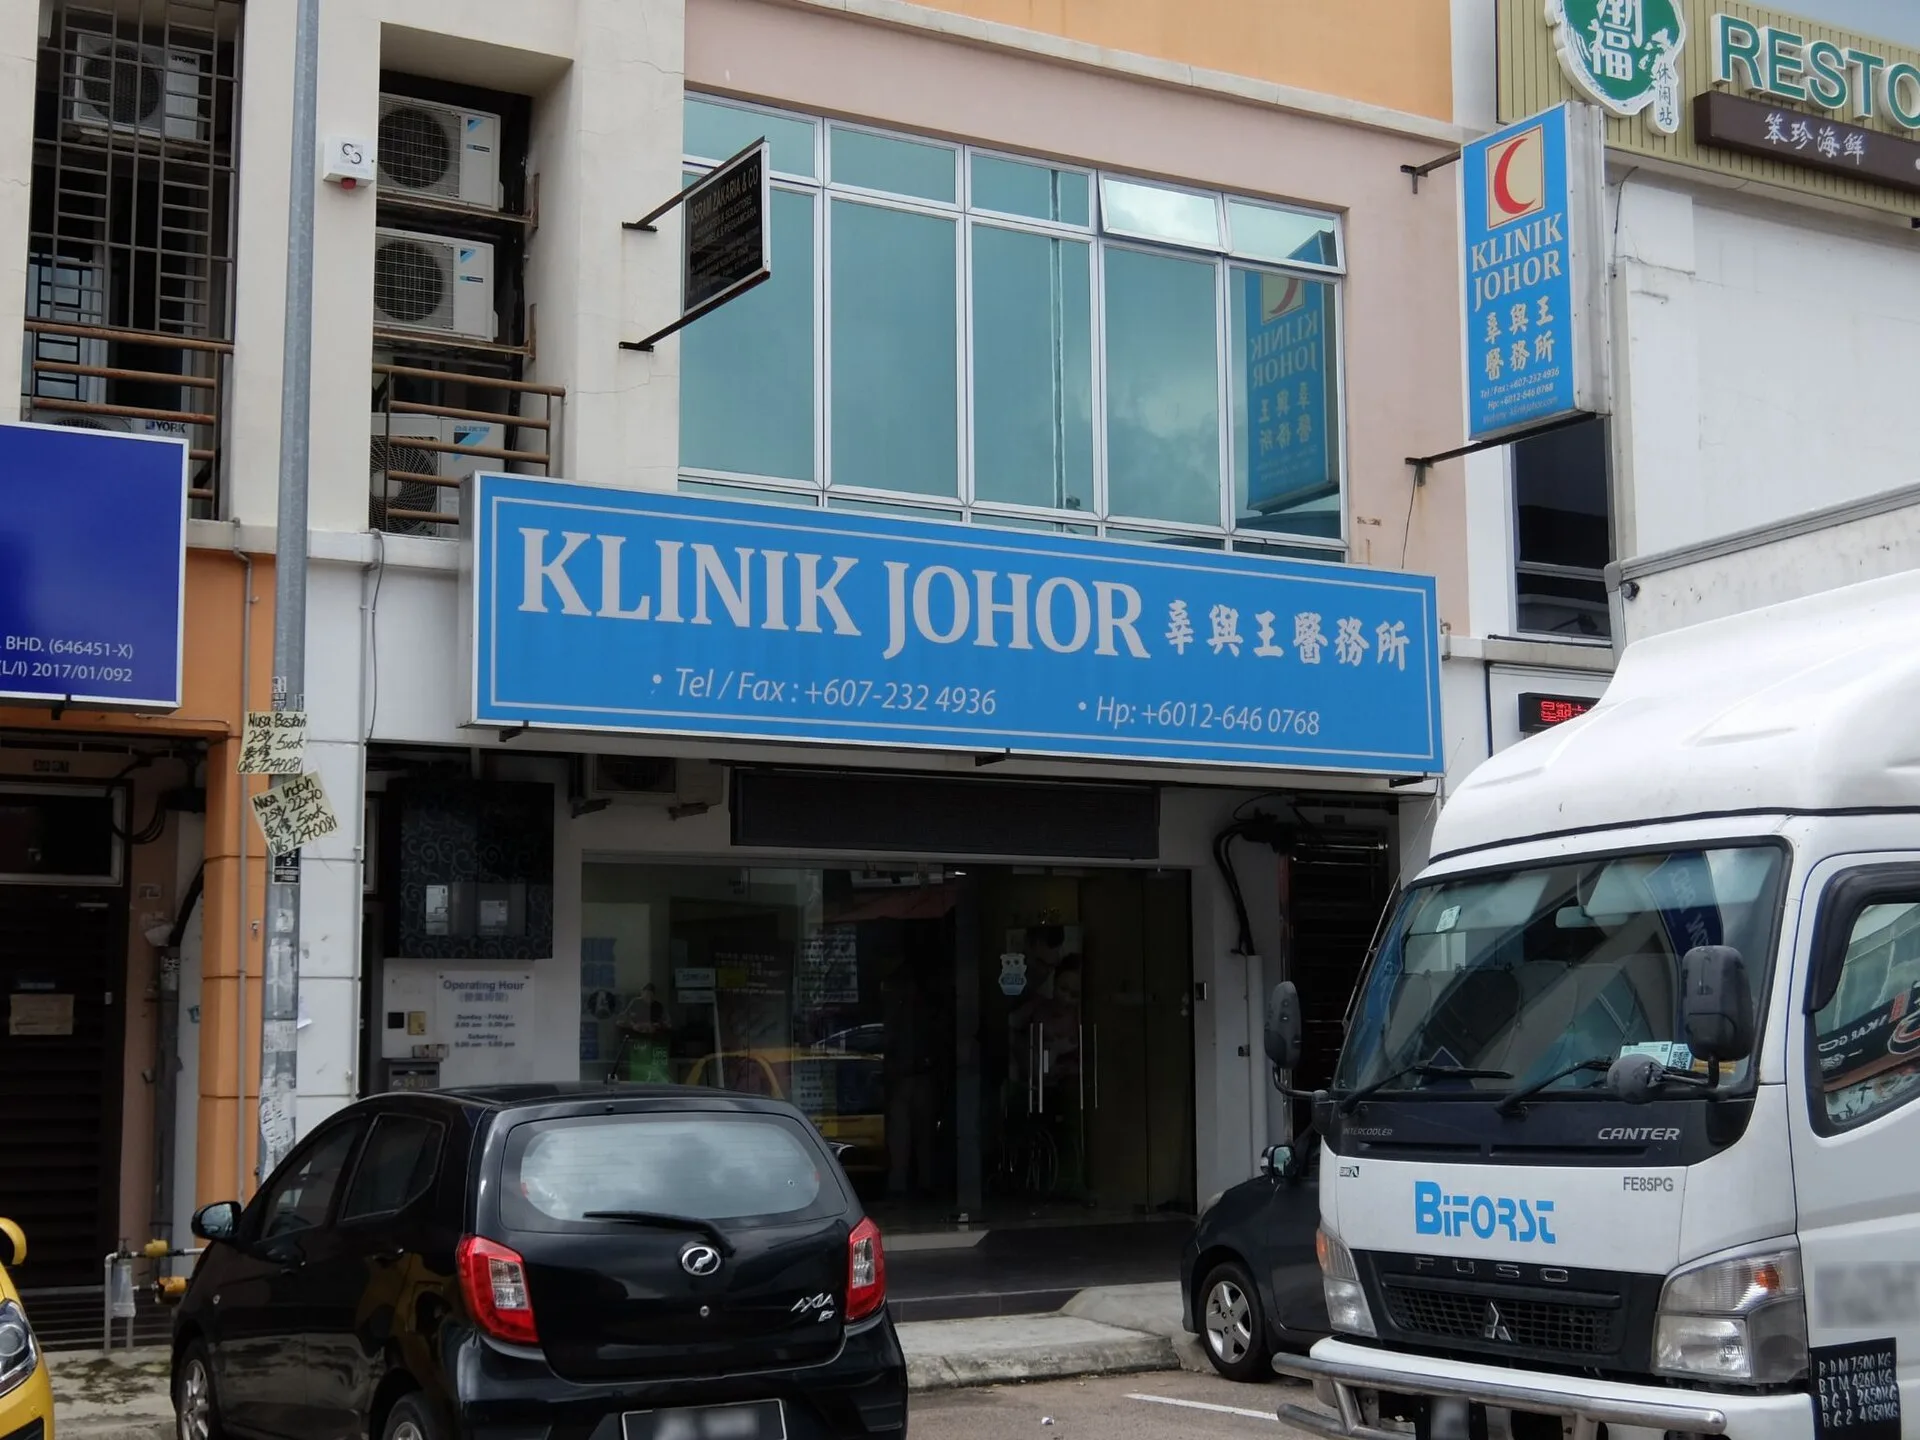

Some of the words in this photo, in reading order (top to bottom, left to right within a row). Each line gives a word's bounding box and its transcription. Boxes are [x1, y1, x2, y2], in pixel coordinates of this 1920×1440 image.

[1763, 111, 1866, 165] 笨珍海鲜
[1471, 212, 1563, 273] KLINIK
[1474, 250, 1562, 312] JOHOR
[1485, 330, 1556, 381] 醫務所
[155, 421, 187, 433] YORK
[518, 527, 862, 636] KLINIK
[882, 560, 1152, 660] JOHOR
[6, 636, 45, 652] BHD.
[49, 639, 134, 659] (646451-X)
[32, 662, 133, 682] 2017/01/092
[675, 667, 714, 697] Tel
[805, 678, 929, 711] +607-232
[935, 686, 996, 715] 4936
[248, 712, 271, 728] Nusa
[1096, 696, 1136, 729] Hp:
[1141, 700, 1263, 732] +6012-646
[1267, 709, 1320, 735] 0768
[252, 794, 279, 811] Nusa
[282, 776, 315, 798] Indah
[443, 980, 496, 992] Operating
[499, 980, 525, 991] Hour
[1598, 1127, 1682, 1141] CANTER
[1623, 1176, 1675, 1192] FE85PG
[1414, 1257, 1570, 1283] FUSO
[790, 1292, 835, 1313] AXIA
